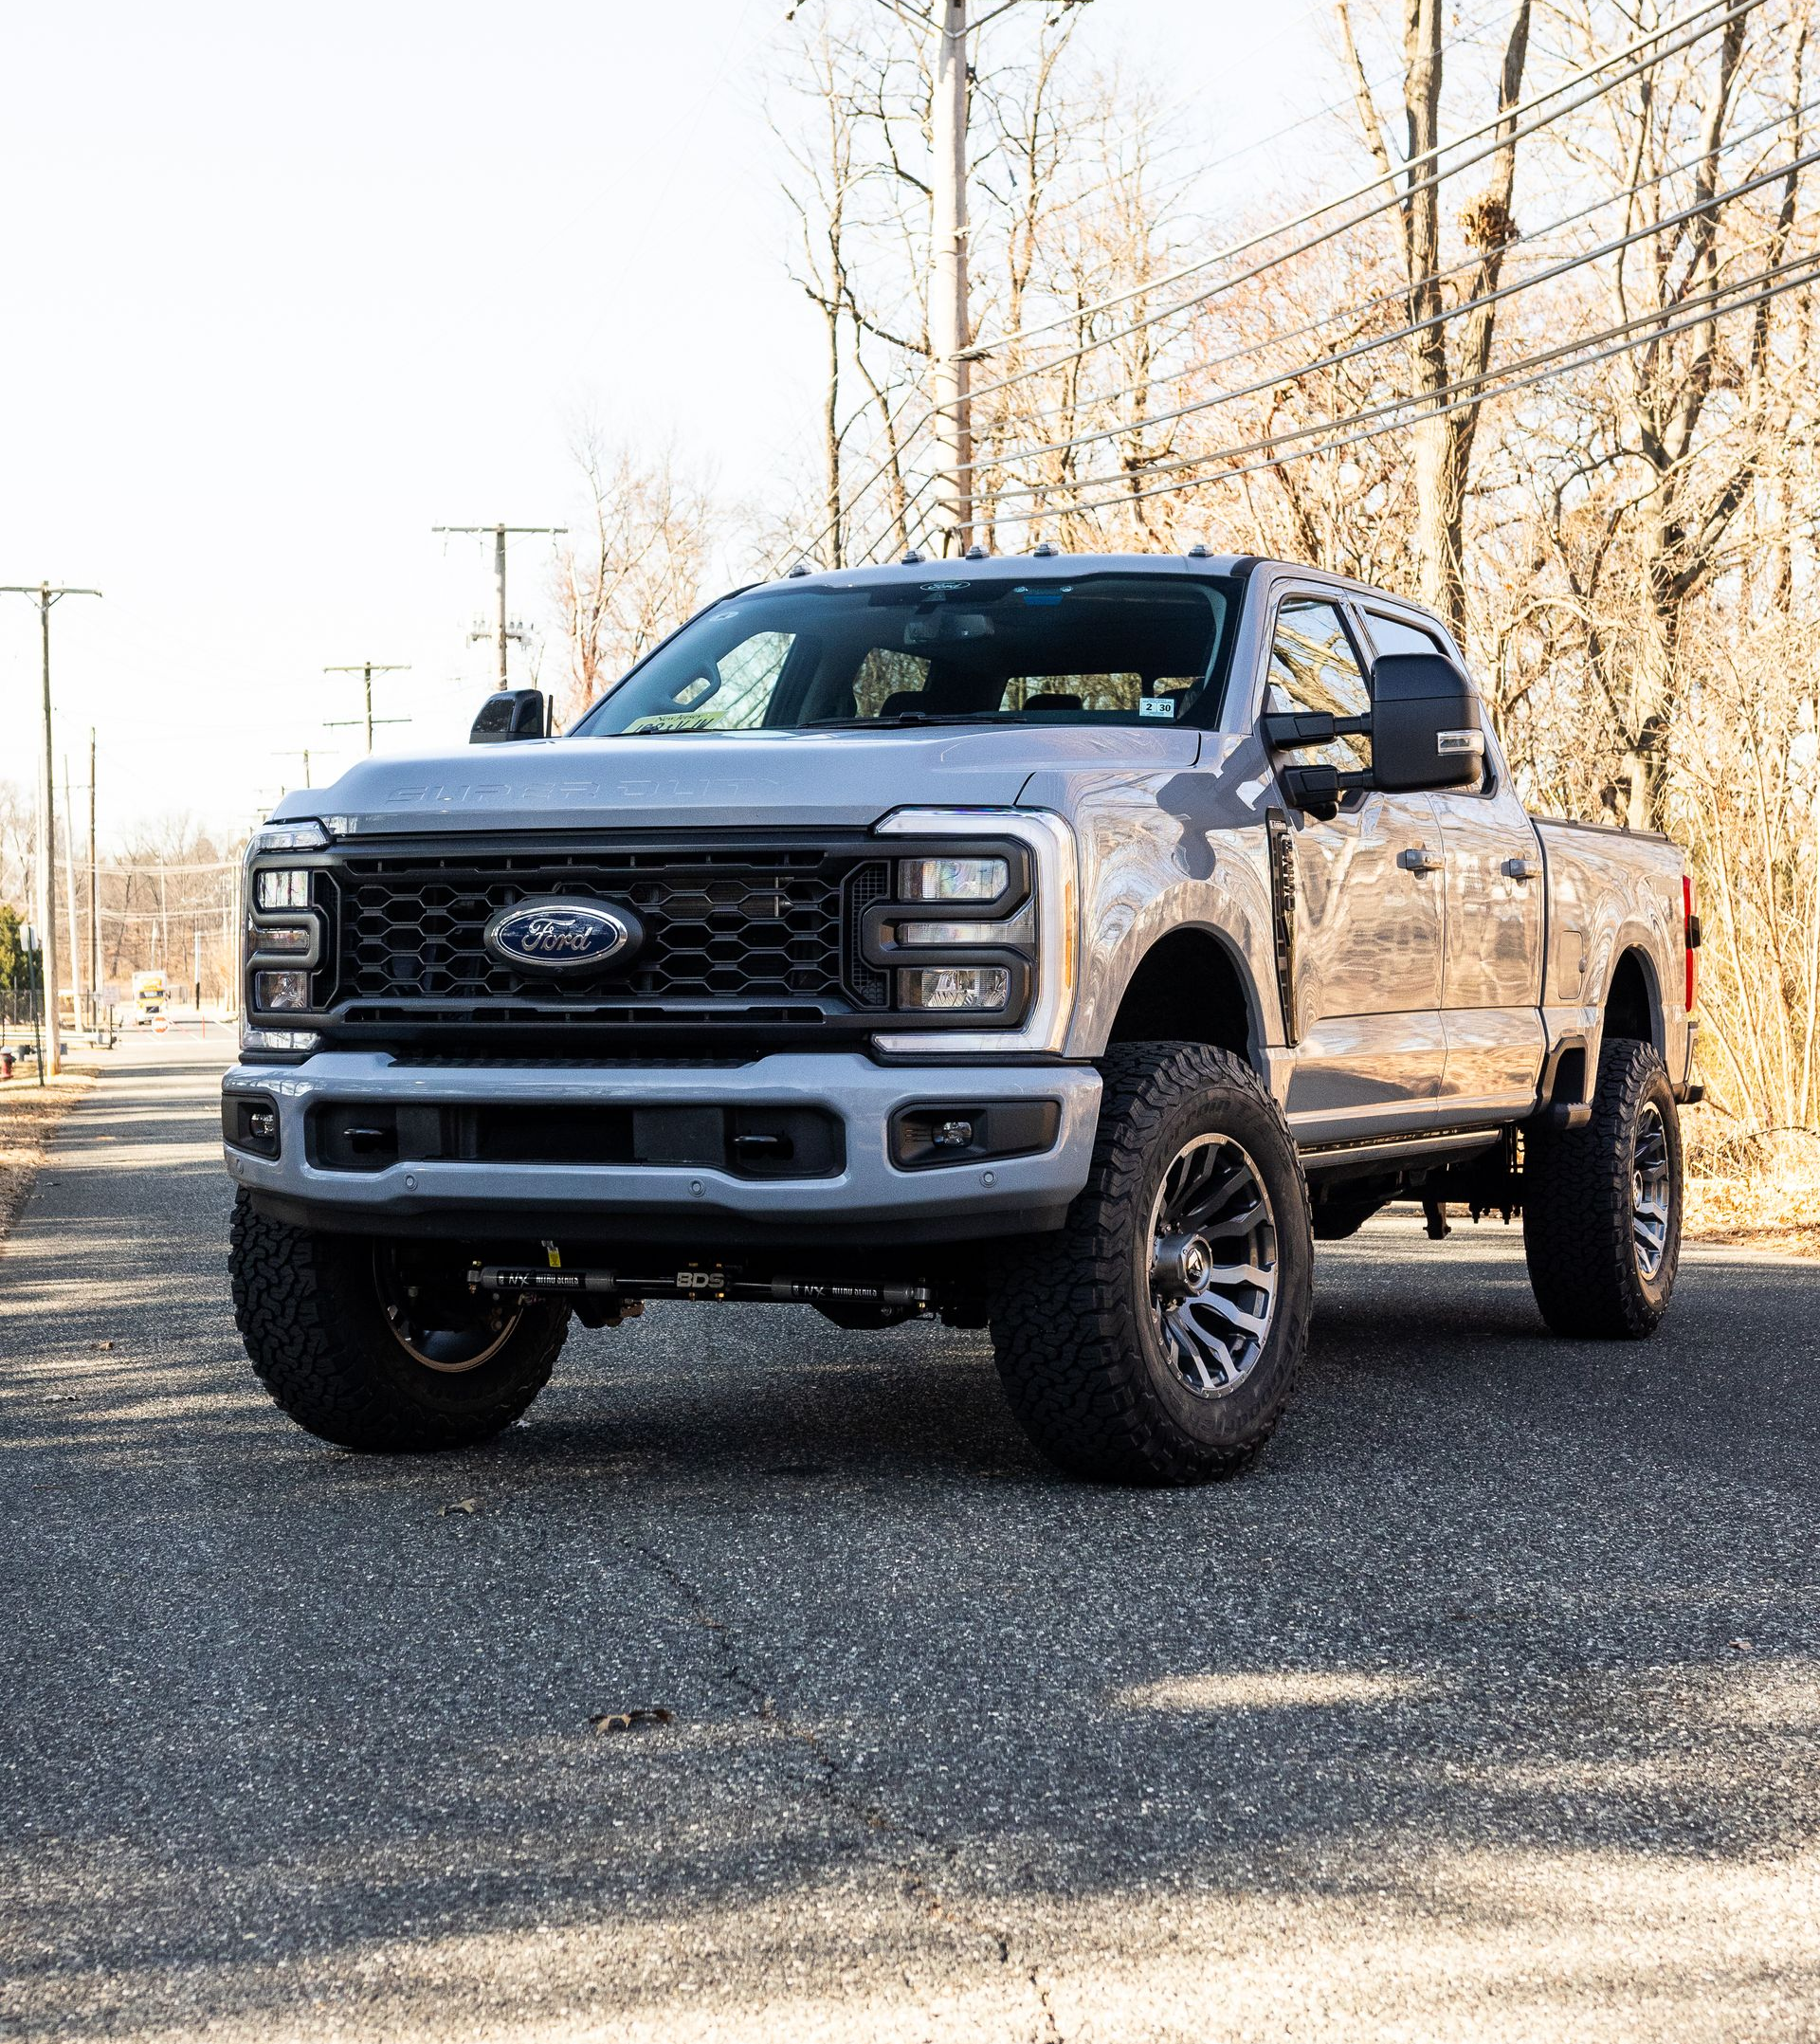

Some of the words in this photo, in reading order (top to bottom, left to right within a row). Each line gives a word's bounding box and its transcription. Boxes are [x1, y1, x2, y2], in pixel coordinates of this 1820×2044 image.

[1145, 703, 1154, 711] 2
[1158, 703, 1172, 712] 30
[385, 781, 601, 804] SUPER
[521, 918, 593, 951] Ford
[677, 1272, 724, 1287] BDS
